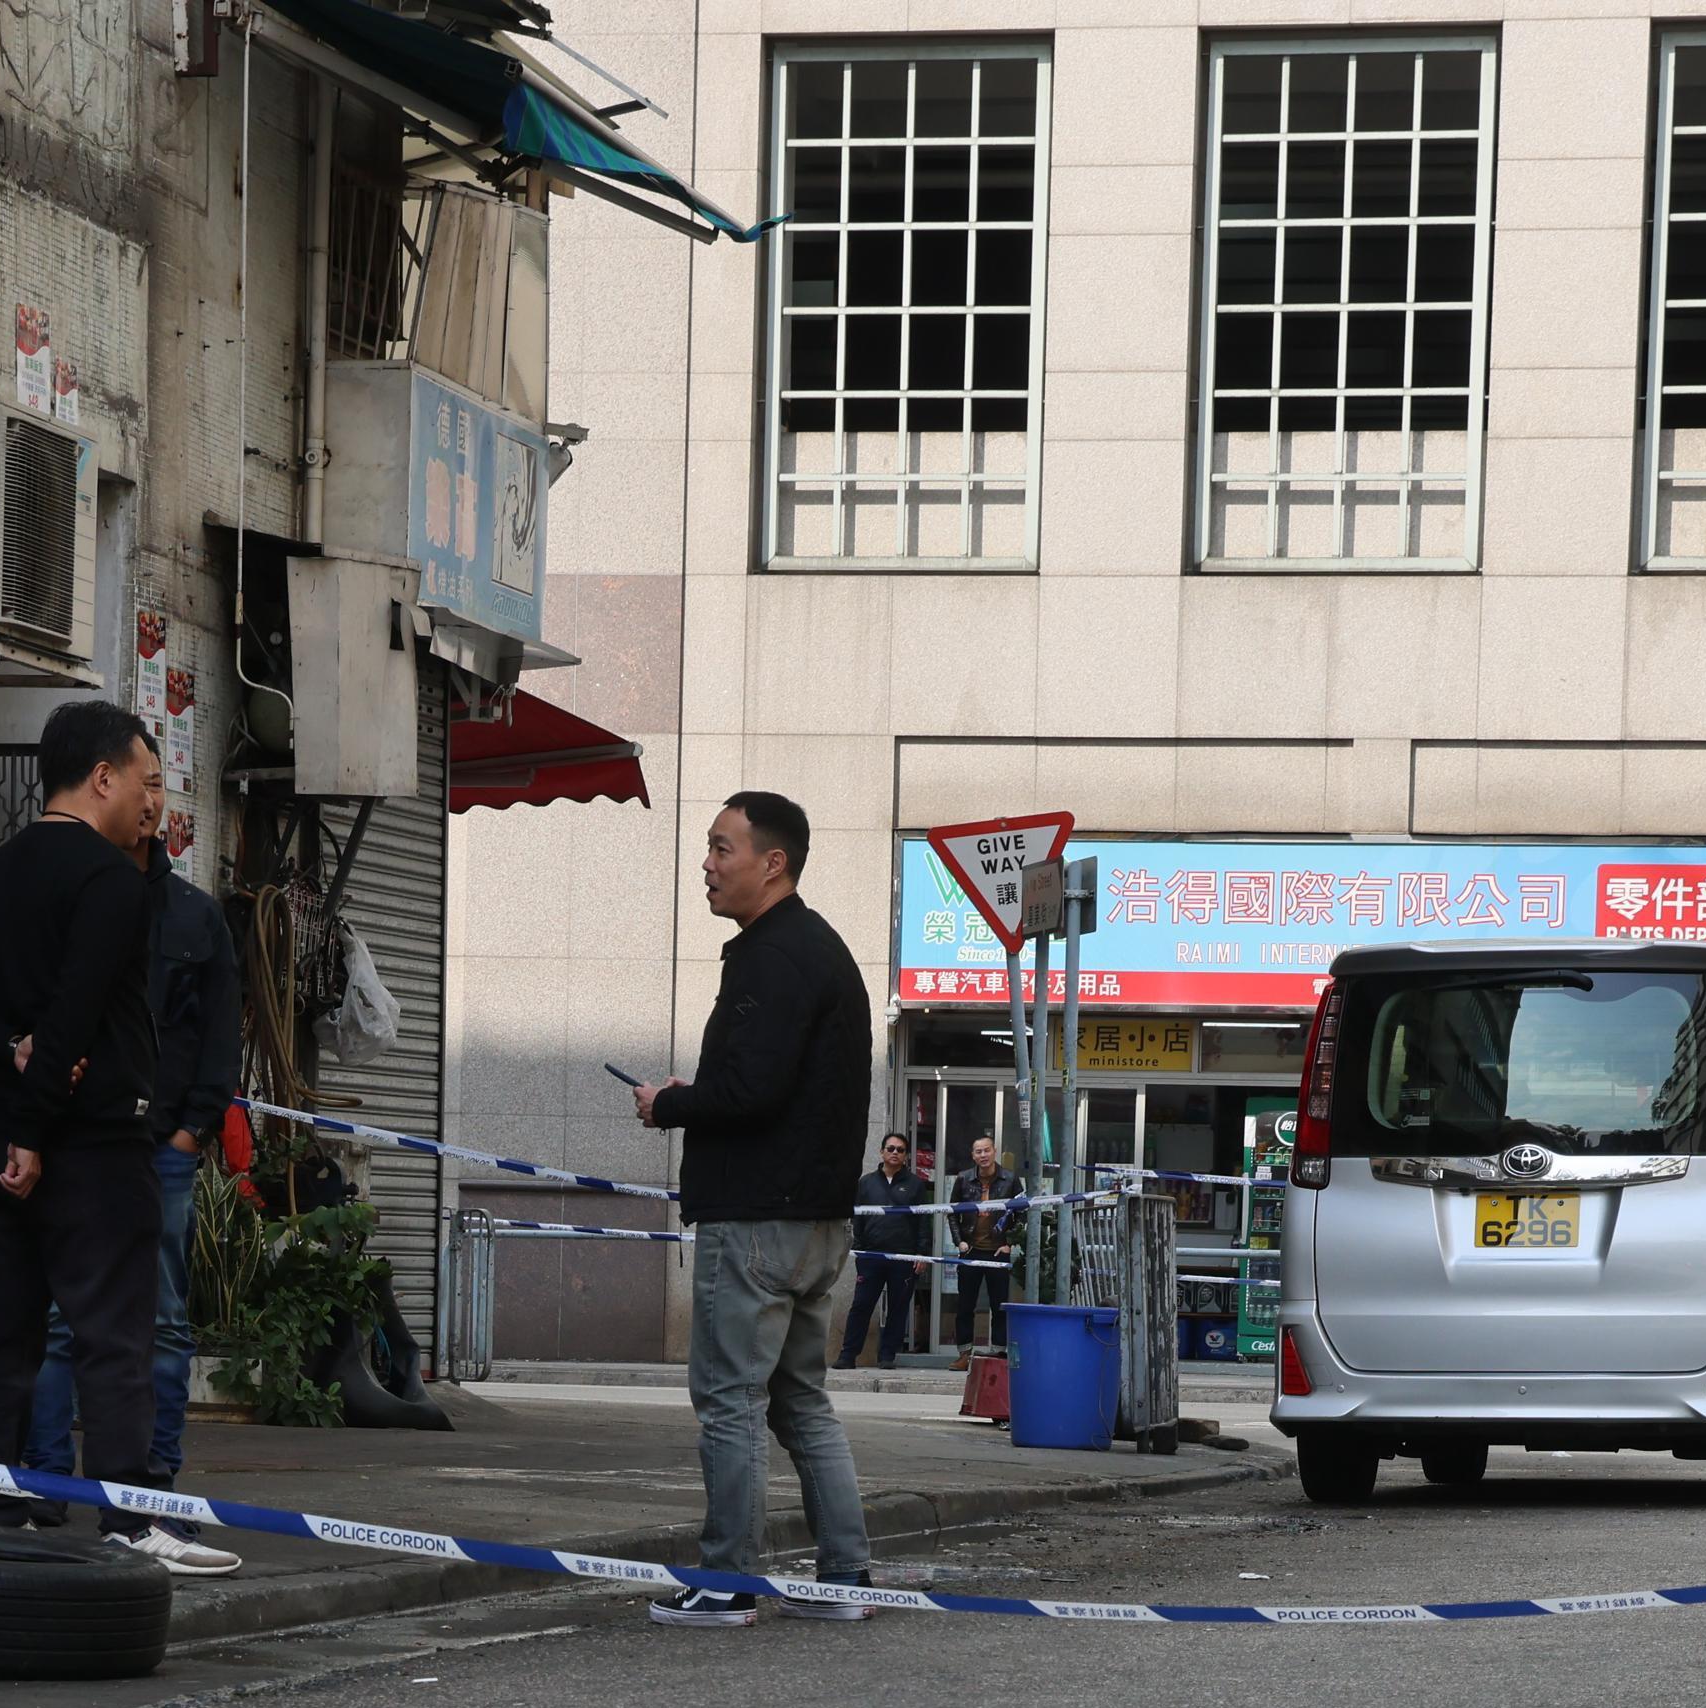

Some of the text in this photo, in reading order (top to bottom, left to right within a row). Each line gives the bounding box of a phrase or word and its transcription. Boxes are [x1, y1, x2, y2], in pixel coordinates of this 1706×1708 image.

[977, 834, 1026, 855] GIVE
[981, 855, 1026, 875] WAY
[996, 882, 1019, 905] 讓
[1107, 869, 1566, 928] 浩得國際有限公司
[1176, 942, 1241, 965] RAIMI
[1089, 1055, 1159, 1067] ministore
[1505, 1195, 1549, 1220] TK
[1481, 1220, 1572, 1246] 6296
[321, 1521, 377, 1544] POLICE
[787, 1582, 841, 1600] POLICE
[1277, 1610, 1339, 1622] POLICE
